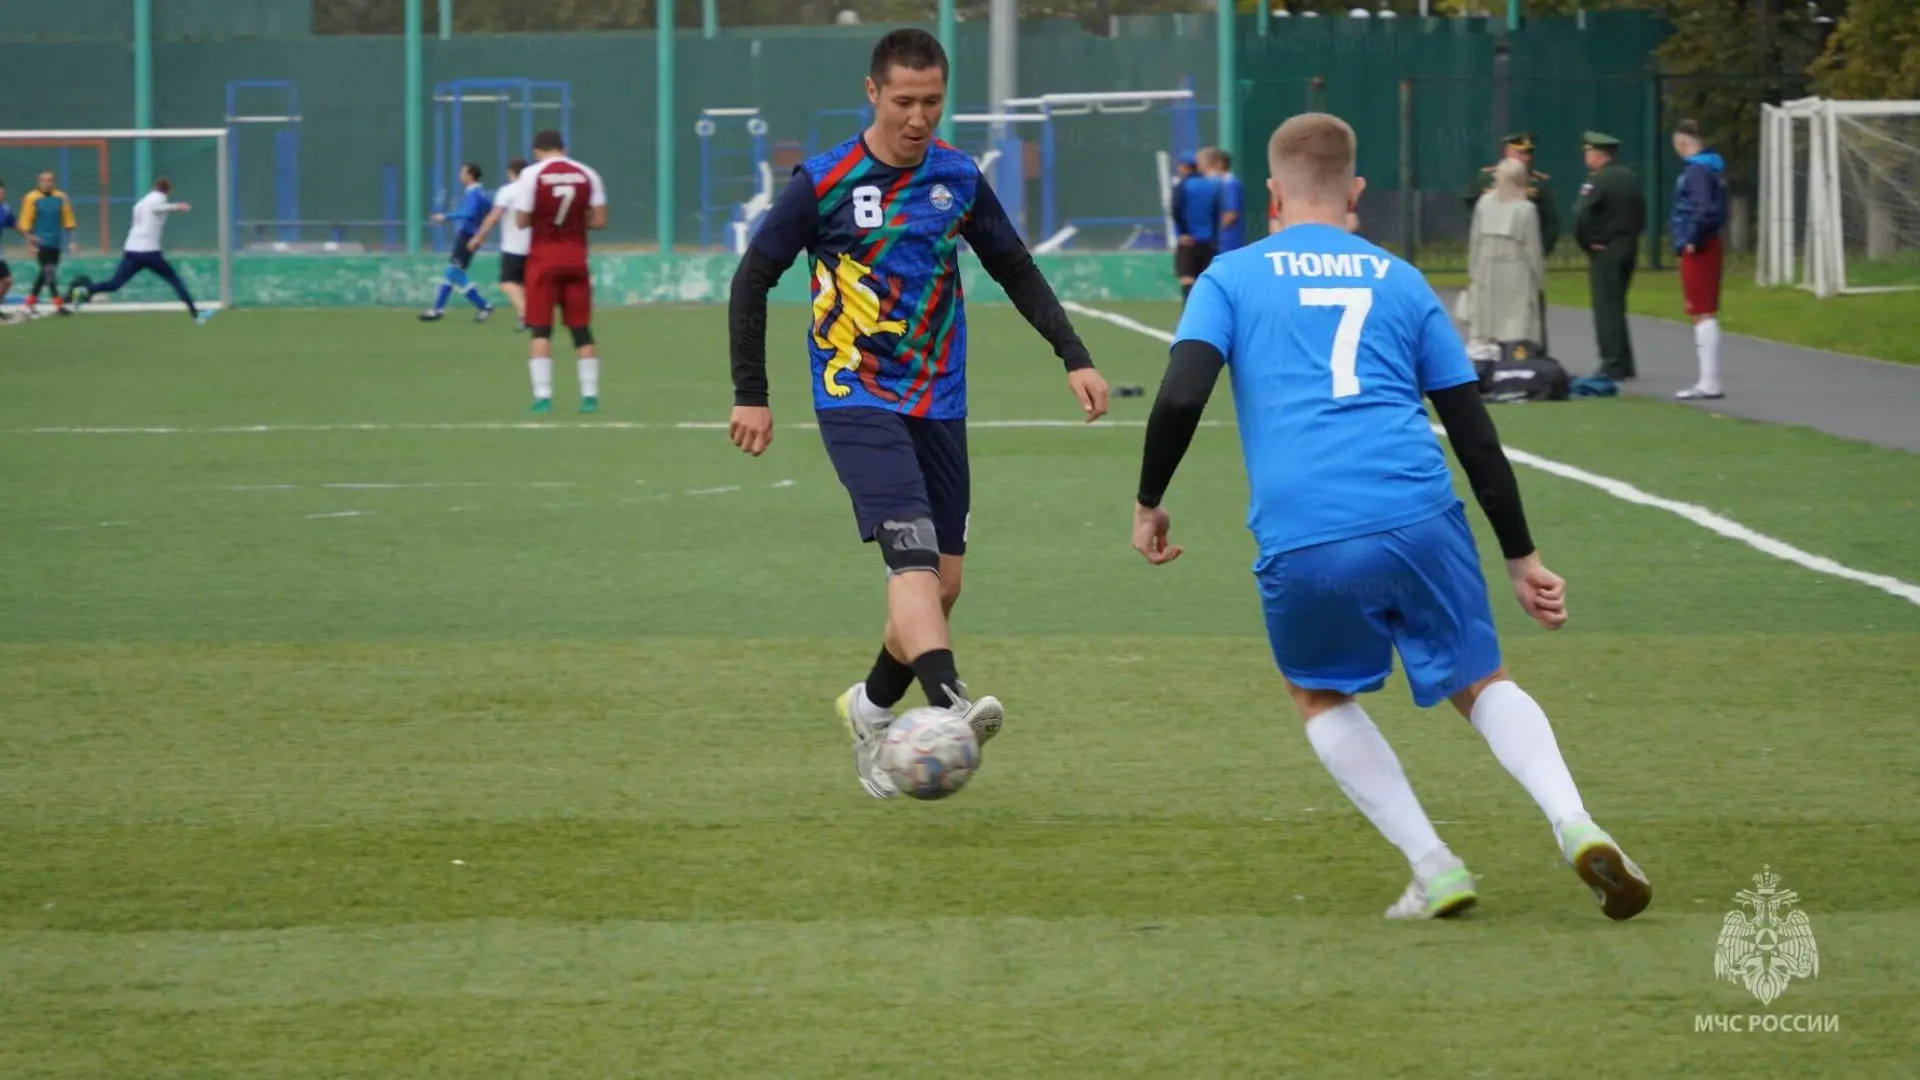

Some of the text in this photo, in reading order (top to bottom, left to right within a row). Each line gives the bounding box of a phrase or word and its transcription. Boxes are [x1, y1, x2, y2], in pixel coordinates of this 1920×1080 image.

[552, 185, 576, 226] 7
[852, 185, 883, 228] 8
[1264, 252, 1391, 279] ТЮМГУ
[1299, 287, 1373, 398] 7
